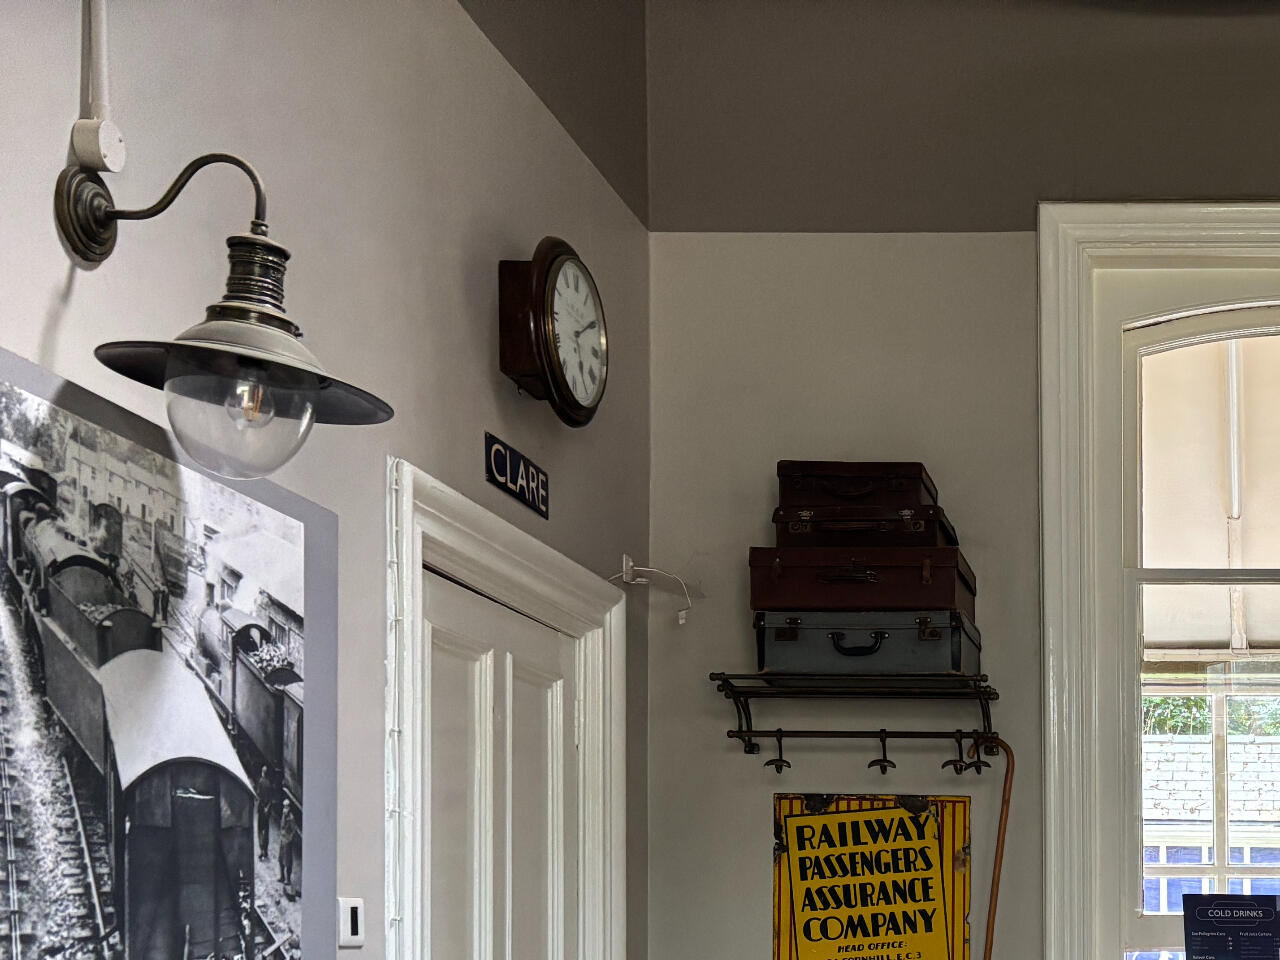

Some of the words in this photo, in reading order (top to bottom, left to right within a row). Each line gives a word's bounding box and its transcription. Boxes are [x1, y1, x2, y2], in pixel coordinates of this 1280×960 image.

[491, 443, 546, 512] CLARE
[796, 814, 929, 851] RAILWAY
[798, 846, 933, 882] PASSENGERS
[801, 877, 936, 913] ASSURANCE
[803, 907, 937, 942] COMPANY
[1208, 909, 1232, 917] COLD
[1233, 910, 1263, 918] DRINKS
[837, 944, 865, 953] HEAD
